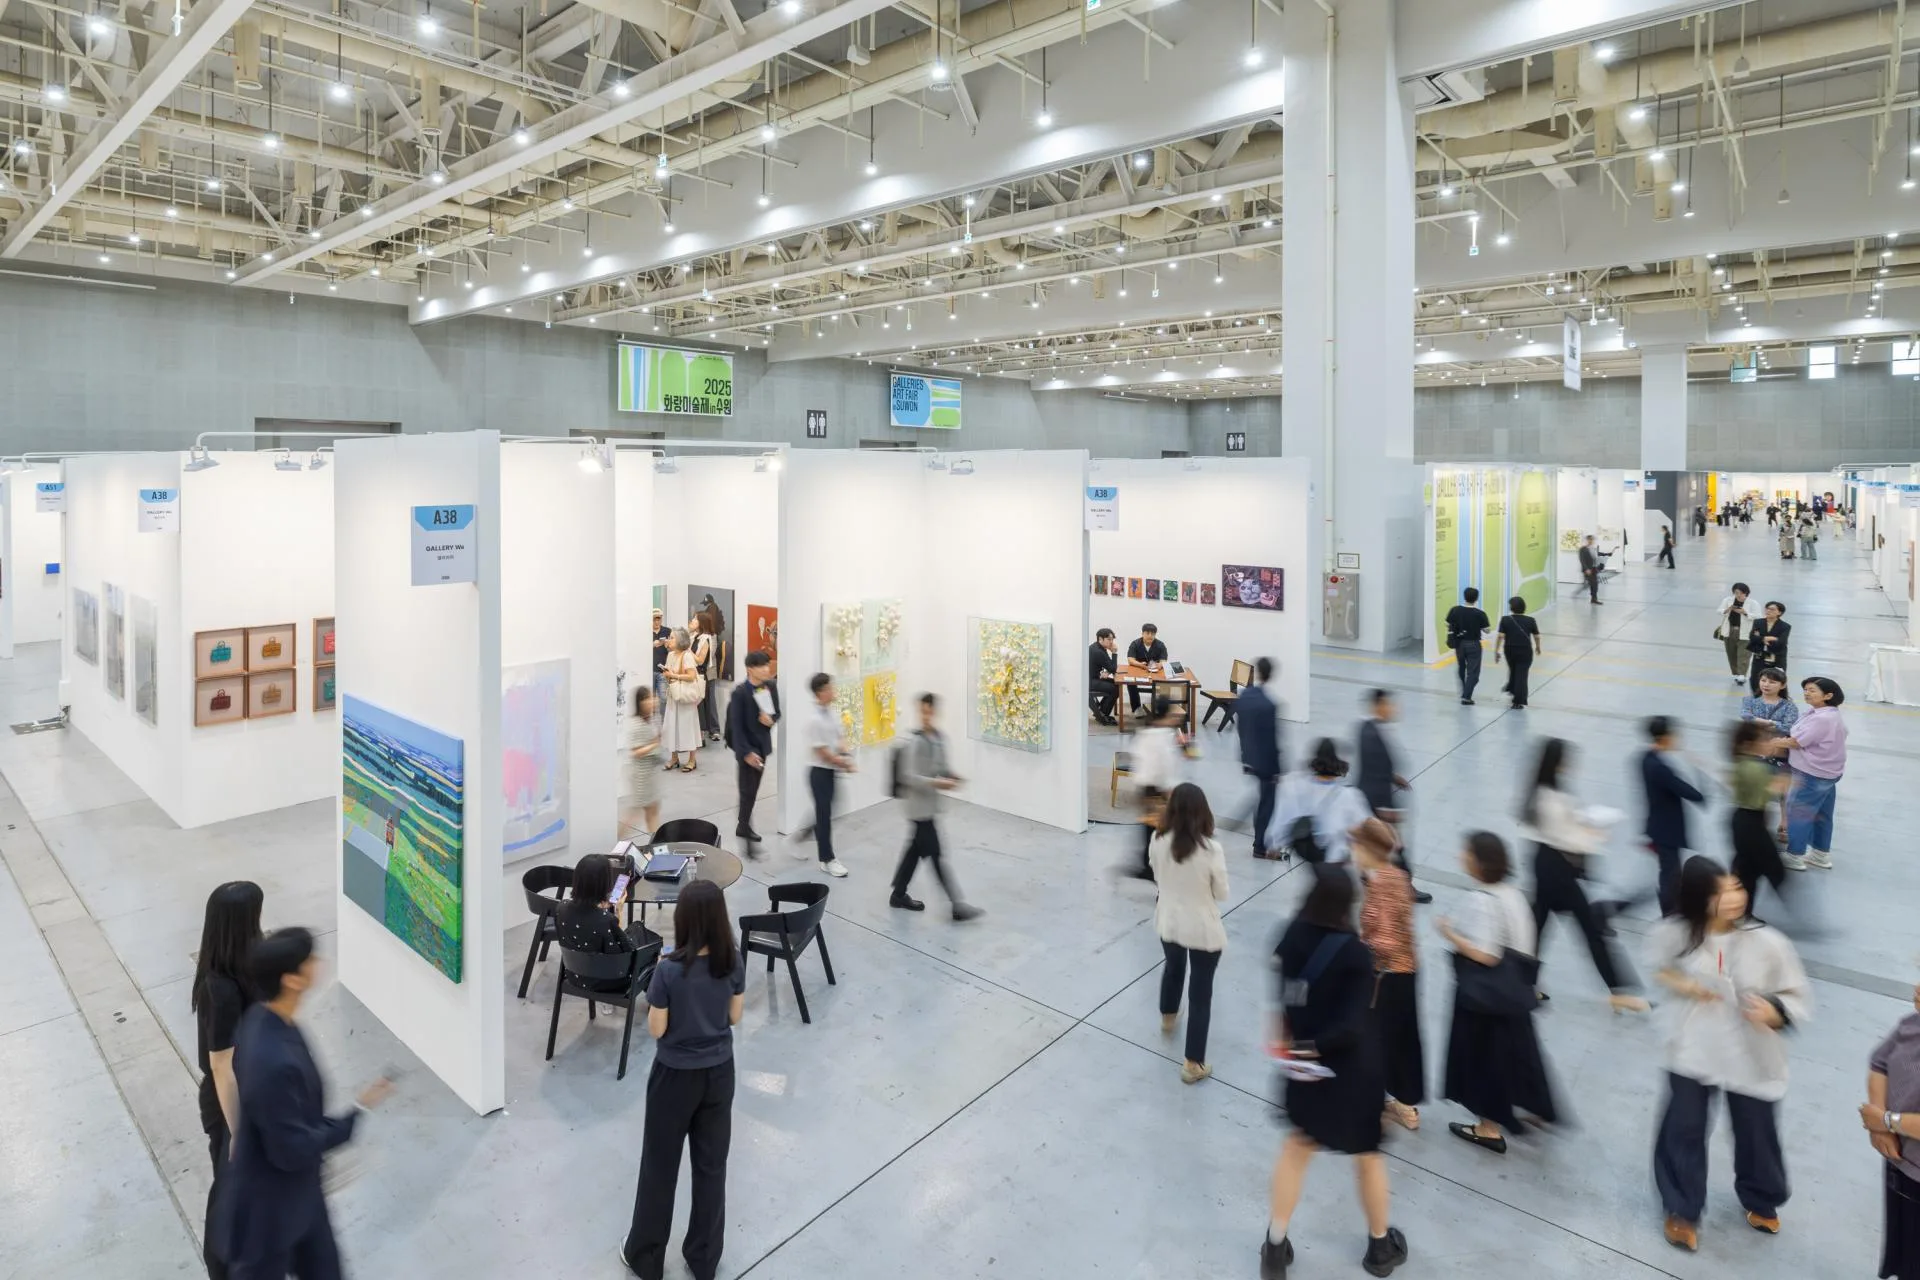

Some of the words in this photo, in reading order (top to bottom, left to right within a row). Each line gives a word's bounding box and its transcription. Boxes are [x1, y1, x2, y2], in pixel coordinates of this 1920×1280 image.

[704, 378, 731, 396] 2025
[893, 376, 924, 390] GALLERIES
[893, 388, 904, 399] ART
[905, 389, 919, 401] FAIR
[896, 399, 918, 412] SUWON
[151, 491, 168, 500] A38
[1094, 489, 1108, 498] A38
[433, 509, 457, 525] A38
